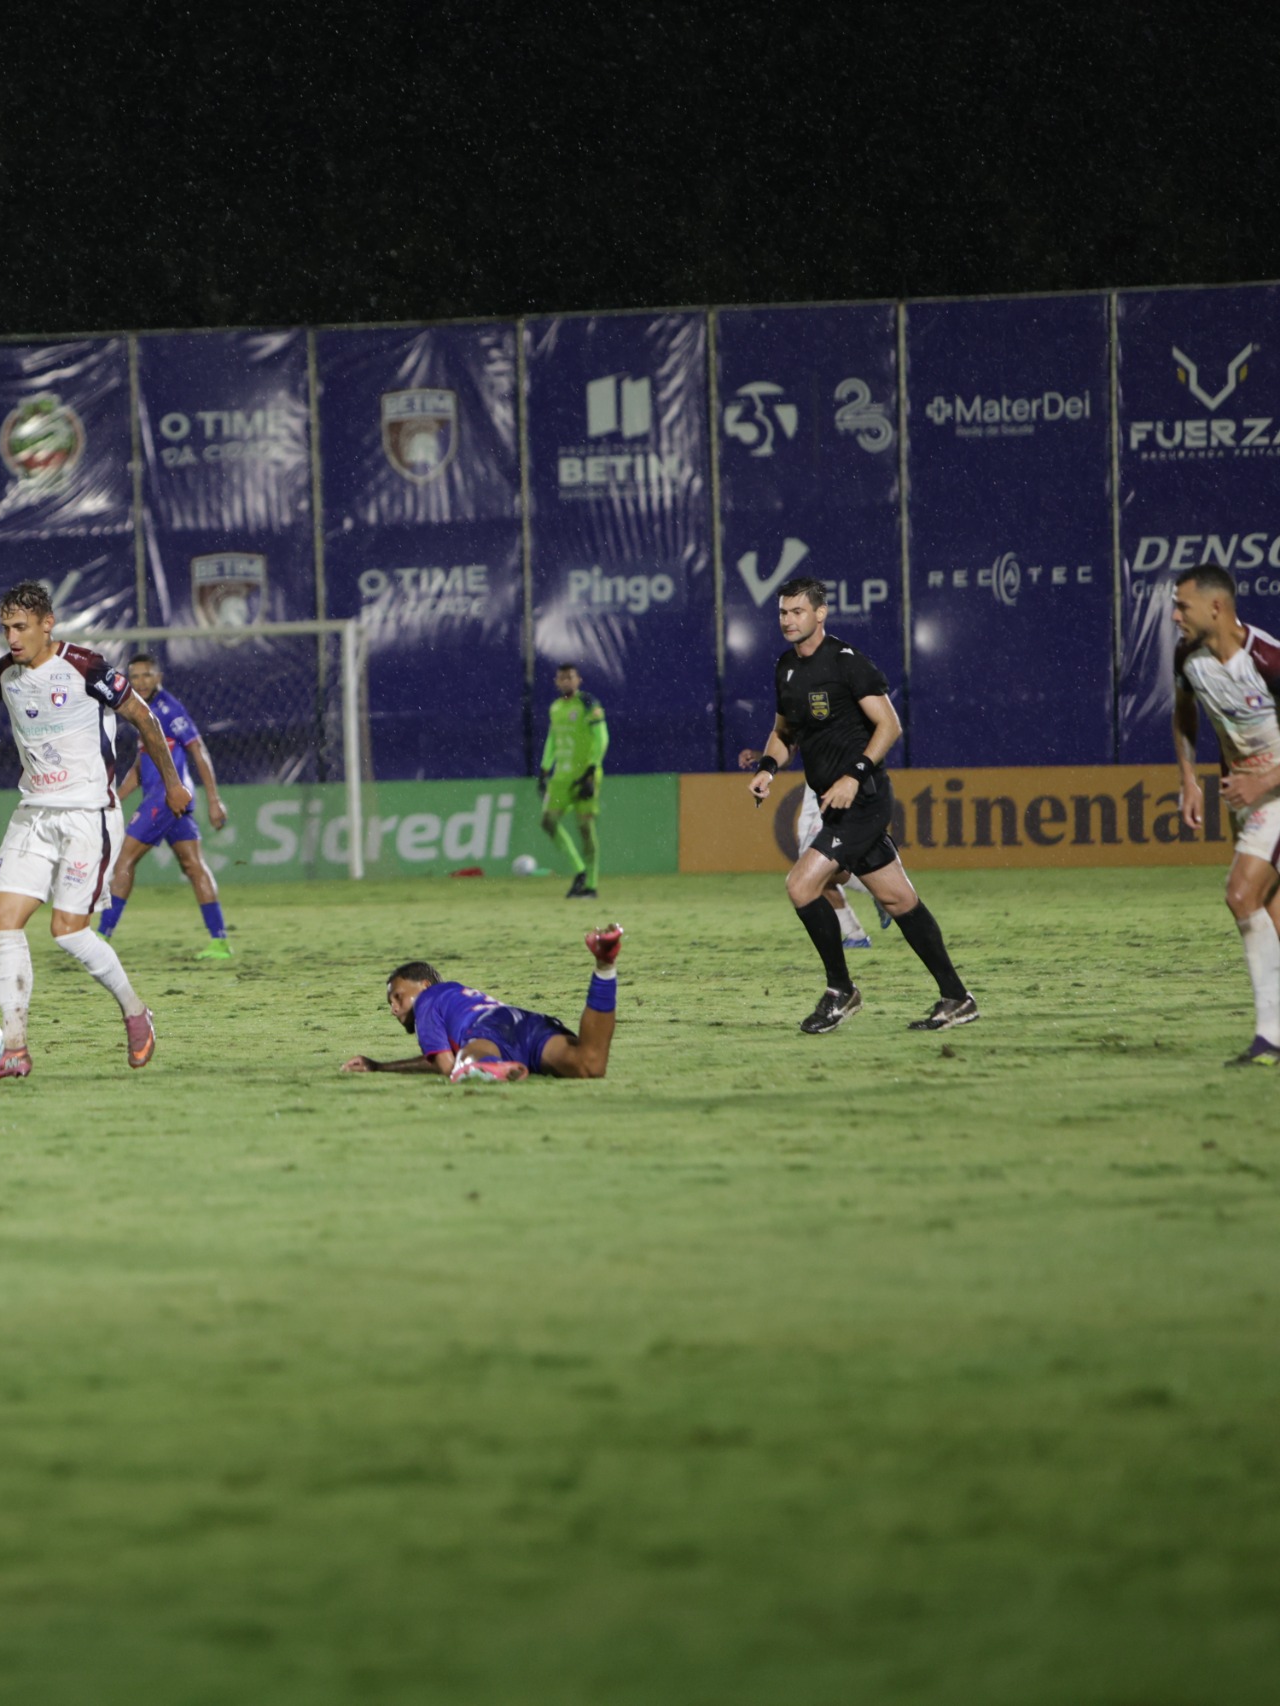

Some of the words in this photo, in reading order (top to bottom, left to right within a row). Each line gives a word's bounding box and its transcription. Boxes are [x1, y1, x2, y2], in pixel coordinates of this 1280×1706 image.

[160, 412, 191, 441] O
[955, 389, 1090, 423] MaterDei
[358, 568, 388, 597] O
[393, 565, 490, 596] TIME
[568, 565, 674, 614] Pingo
[251, 793, 515, 865] Sicredi
[774, 773, 1226, 863] Ctinental
